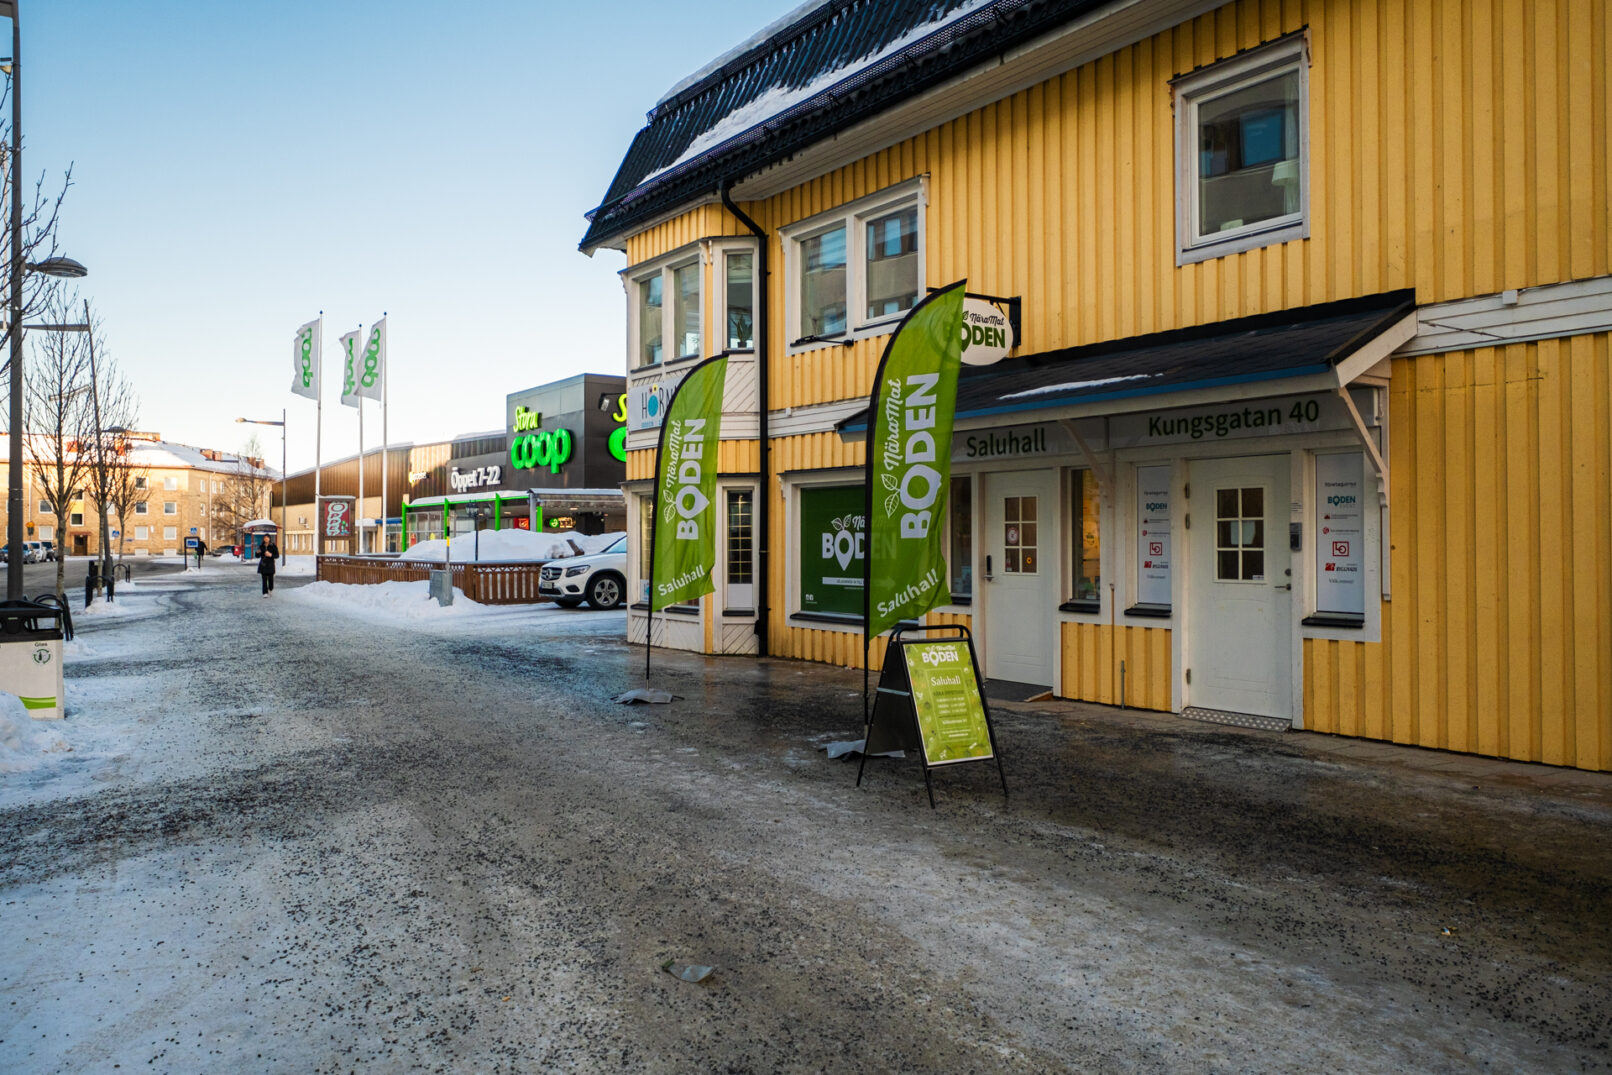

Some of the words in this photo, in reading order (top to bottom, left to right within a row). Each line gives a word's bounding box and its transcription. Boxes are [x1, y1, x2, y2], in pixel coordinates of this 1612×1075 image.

[961, 321, 1005, 352] ODEN
[513, 405, 539, 433] Stora
[1149, 407, 1282, 439] Kungsgatan
[1289, 400, 1319, 423] 40
[511, 428, 572, 474] coop
[900, 372, 942, 539] BODEN
[966, 427, 1047, 458] Saluhall
[450, 466, 478, 493] Öppet
[477, 465, 501, 486] 7-22
[676, 418, 710, 540] BODEN
[1327, 495, 1356, 507] BODEN
[658, 564, 705, 596] Saluhall
[876, 568, 939, 618] Saluhall
[922, 650, 959, 667] BODEN
[931, 675, 961, 687] Saluhall
